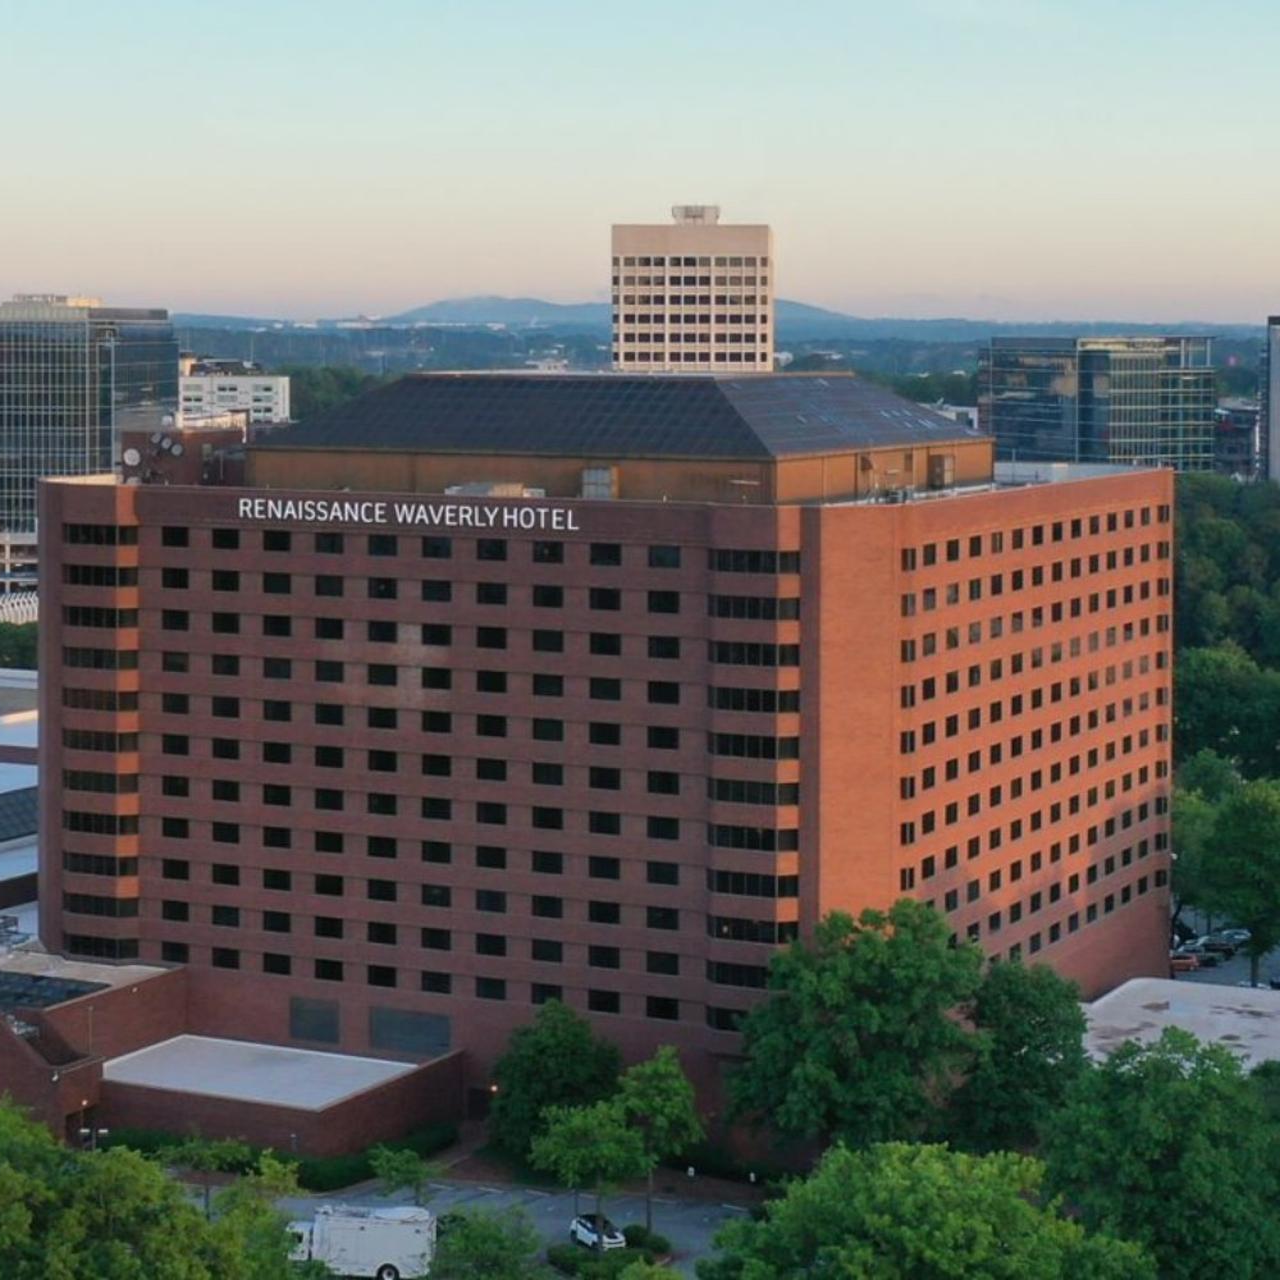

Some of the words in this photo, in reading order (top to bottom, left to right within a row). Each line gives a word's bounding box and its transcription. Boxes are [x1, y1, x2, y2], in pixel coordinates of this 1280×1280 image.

[239, 497, 387, 523] RENAISSANCE
[394, 503, 499, 527] WAVERLY
[502, 507, 580, 530] HOTEL
